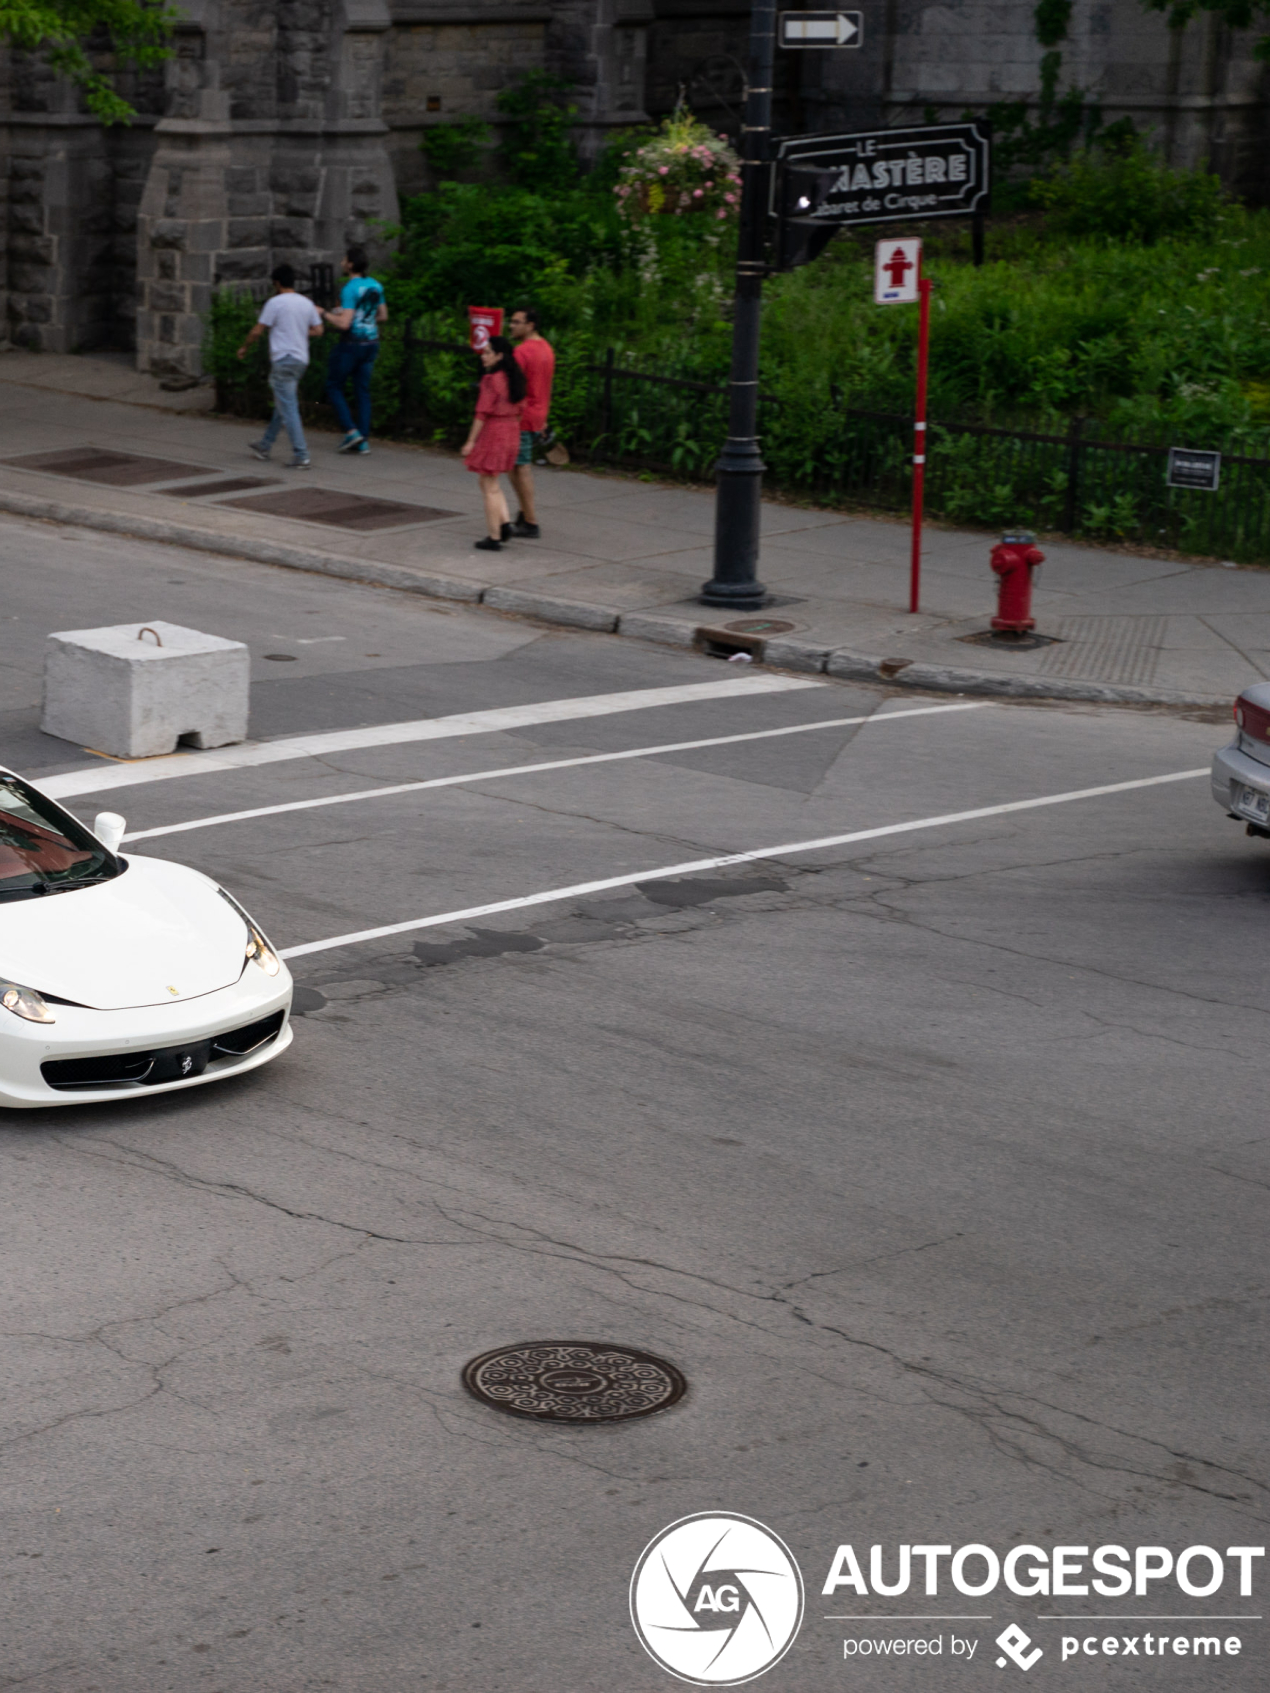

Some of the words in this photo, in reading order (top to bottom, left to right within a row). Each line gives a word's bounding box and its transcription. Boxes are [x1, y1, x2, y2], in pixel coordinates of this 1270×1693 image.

[856, 139, 877, 158] LE
[829, 151, 968, 193] NASTÈRE
[861, 196, 881, 211] de
[883, 193, 939, 210] Cirque
